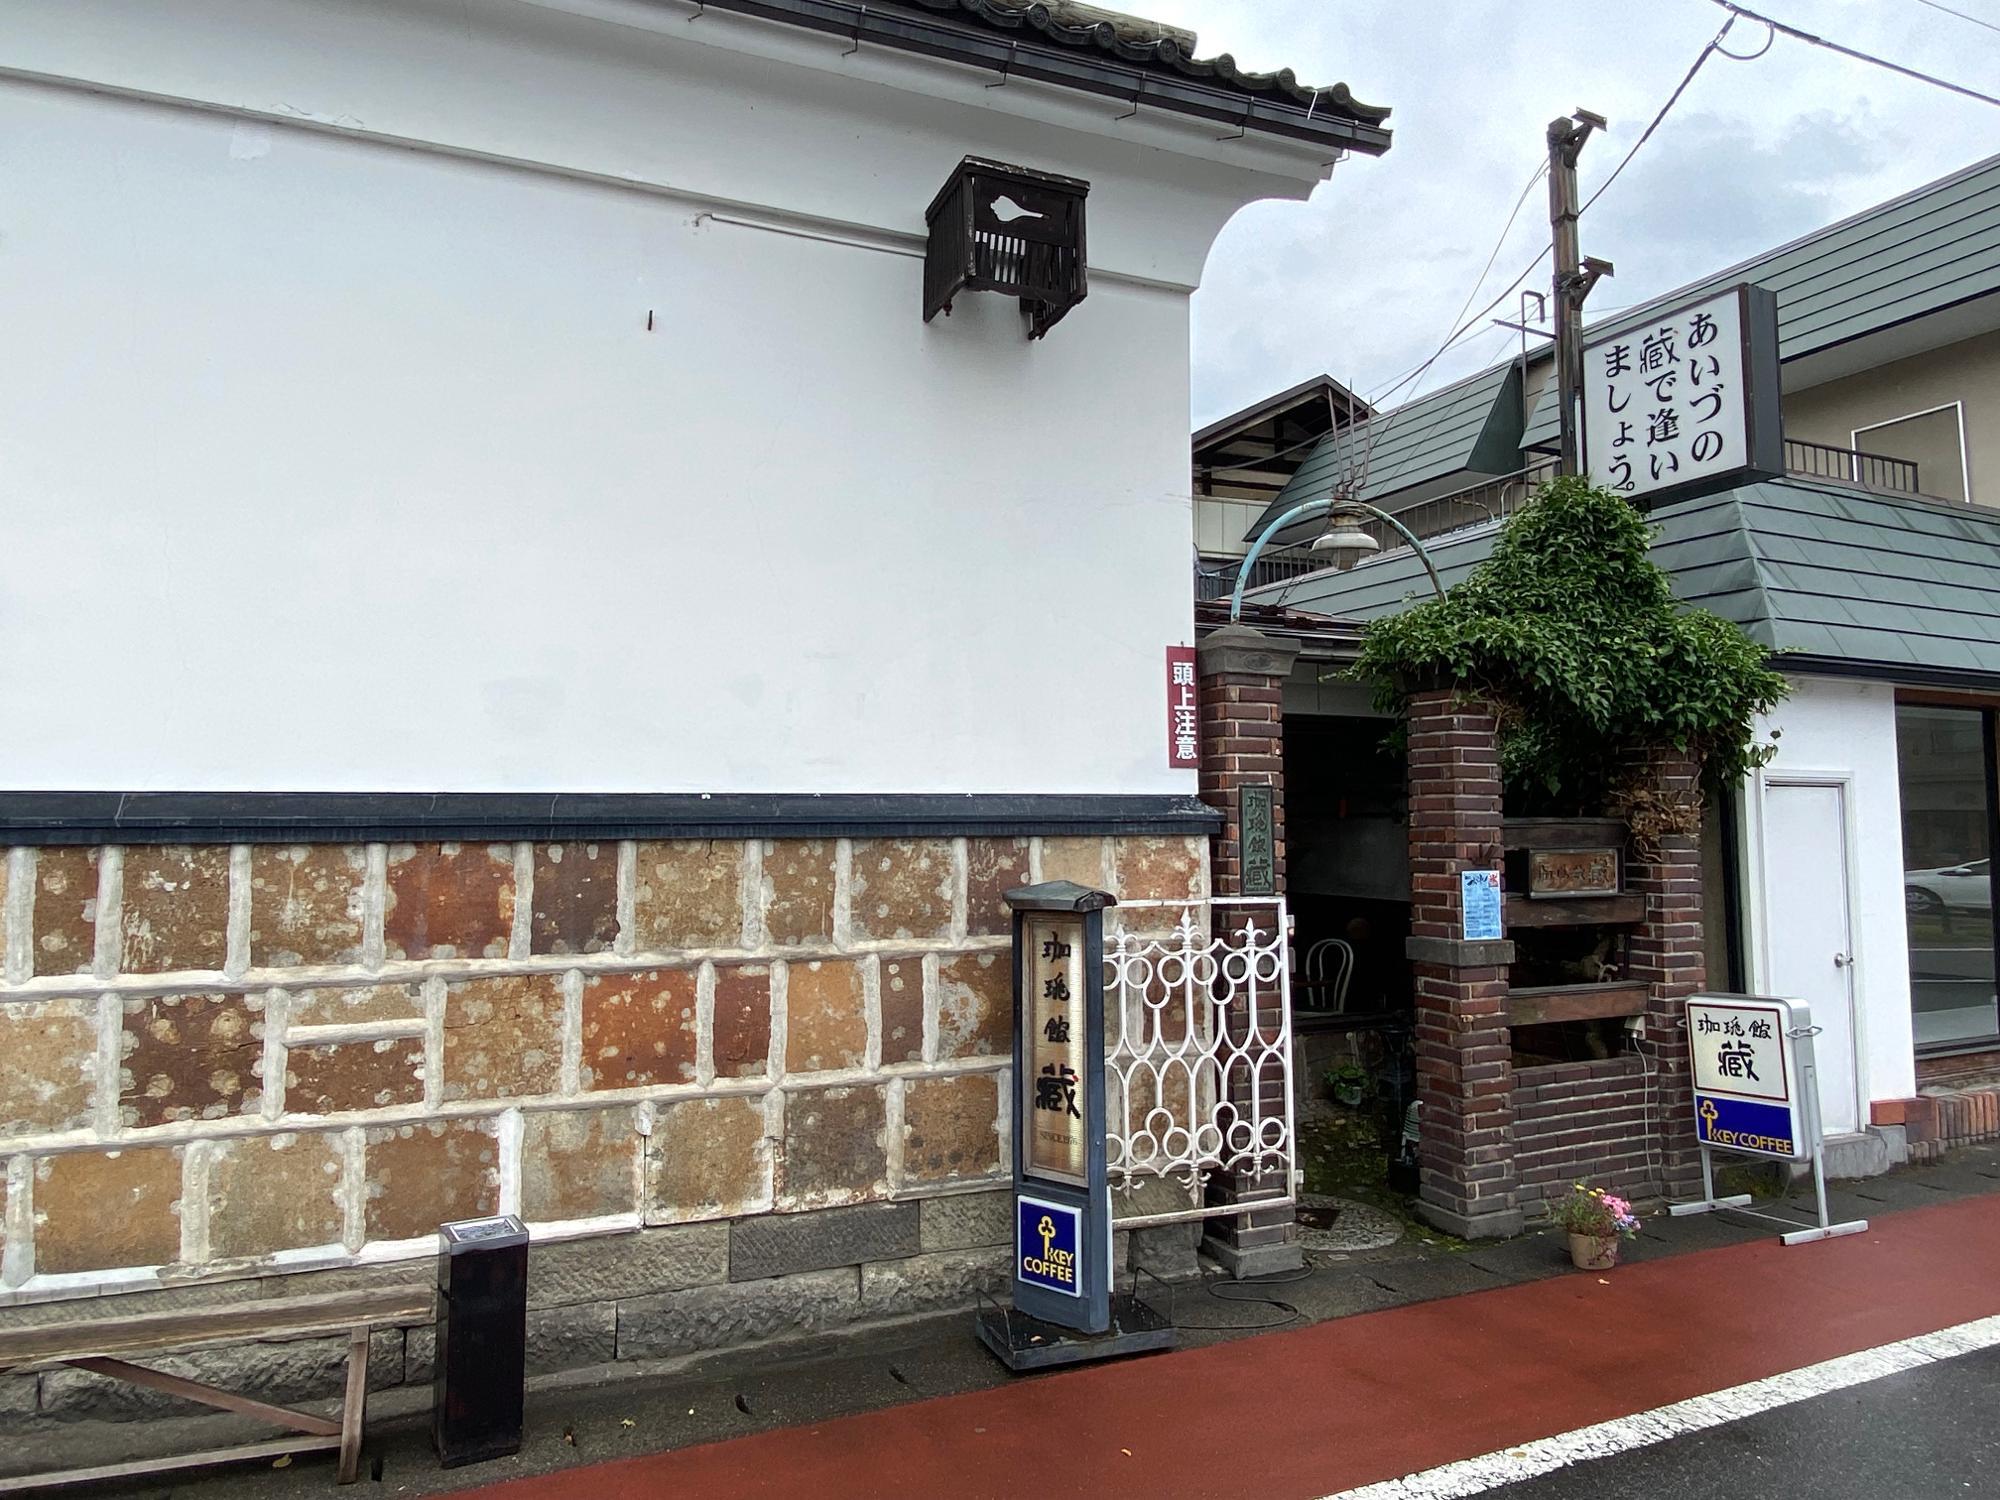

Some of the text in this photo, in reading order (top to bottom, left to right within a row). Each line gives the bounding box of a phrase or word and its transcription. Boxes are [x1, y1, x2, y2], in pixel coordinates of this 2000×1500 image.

[1688, 313, 1724, 462] あいづの
[1173, 661, 1198, 760] 頭上注意
[1711, 1128, 1793, 1154] KEY COFFEE
[1023, 1256, 1073, 1284] COFFEE
[1048, 1247, 1074, 1267] KEY
